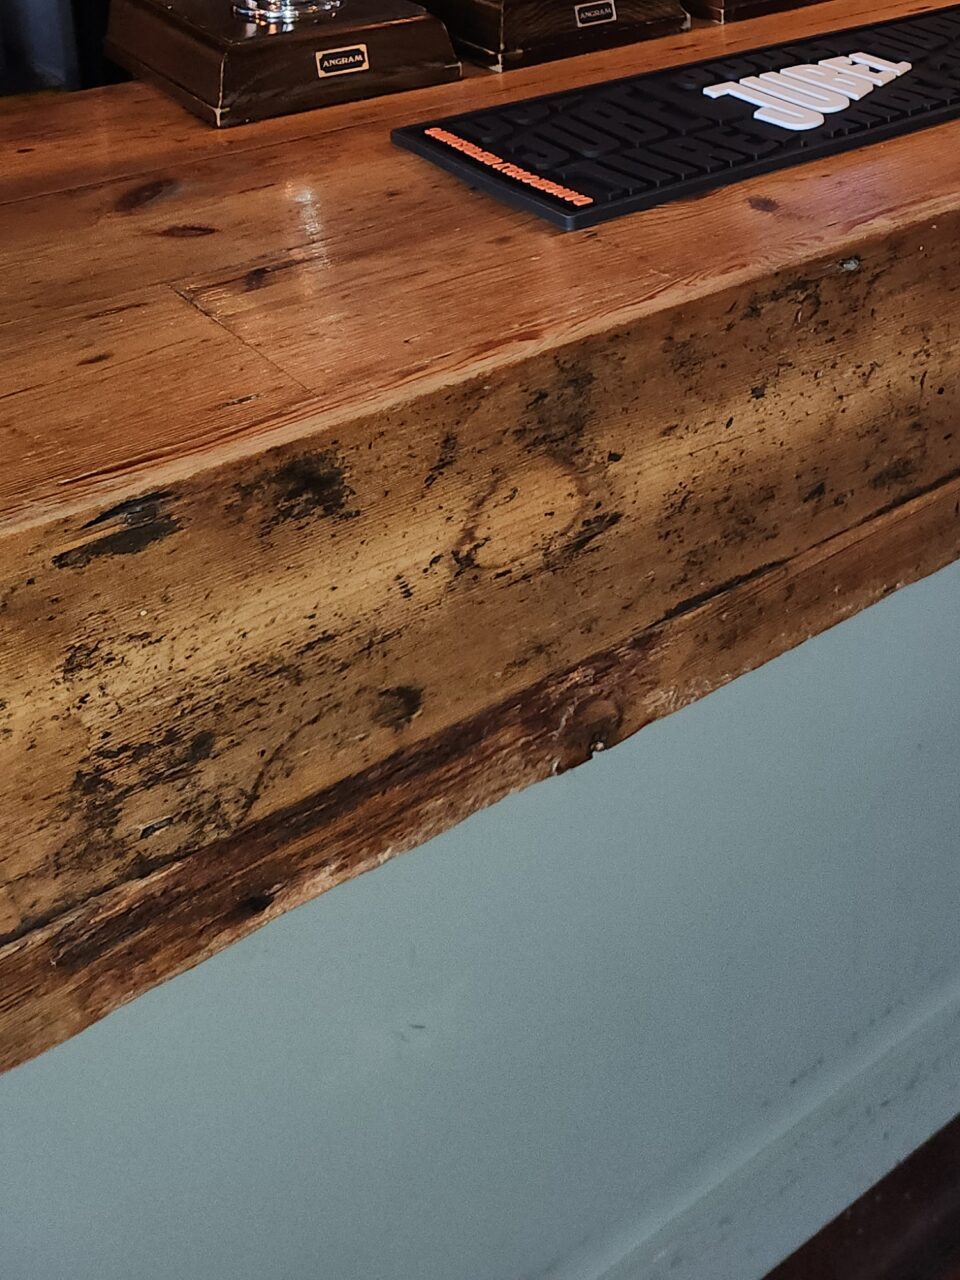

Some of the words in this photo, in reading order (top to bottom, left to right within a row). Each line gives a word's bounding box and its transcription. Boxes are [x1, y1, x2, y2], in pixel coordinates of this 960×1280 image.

[580, 7, 612, 19] ANGRAM
[322, 54, 364, 68] ANGRAM
[702, 52, 914, 131] JUBEL
